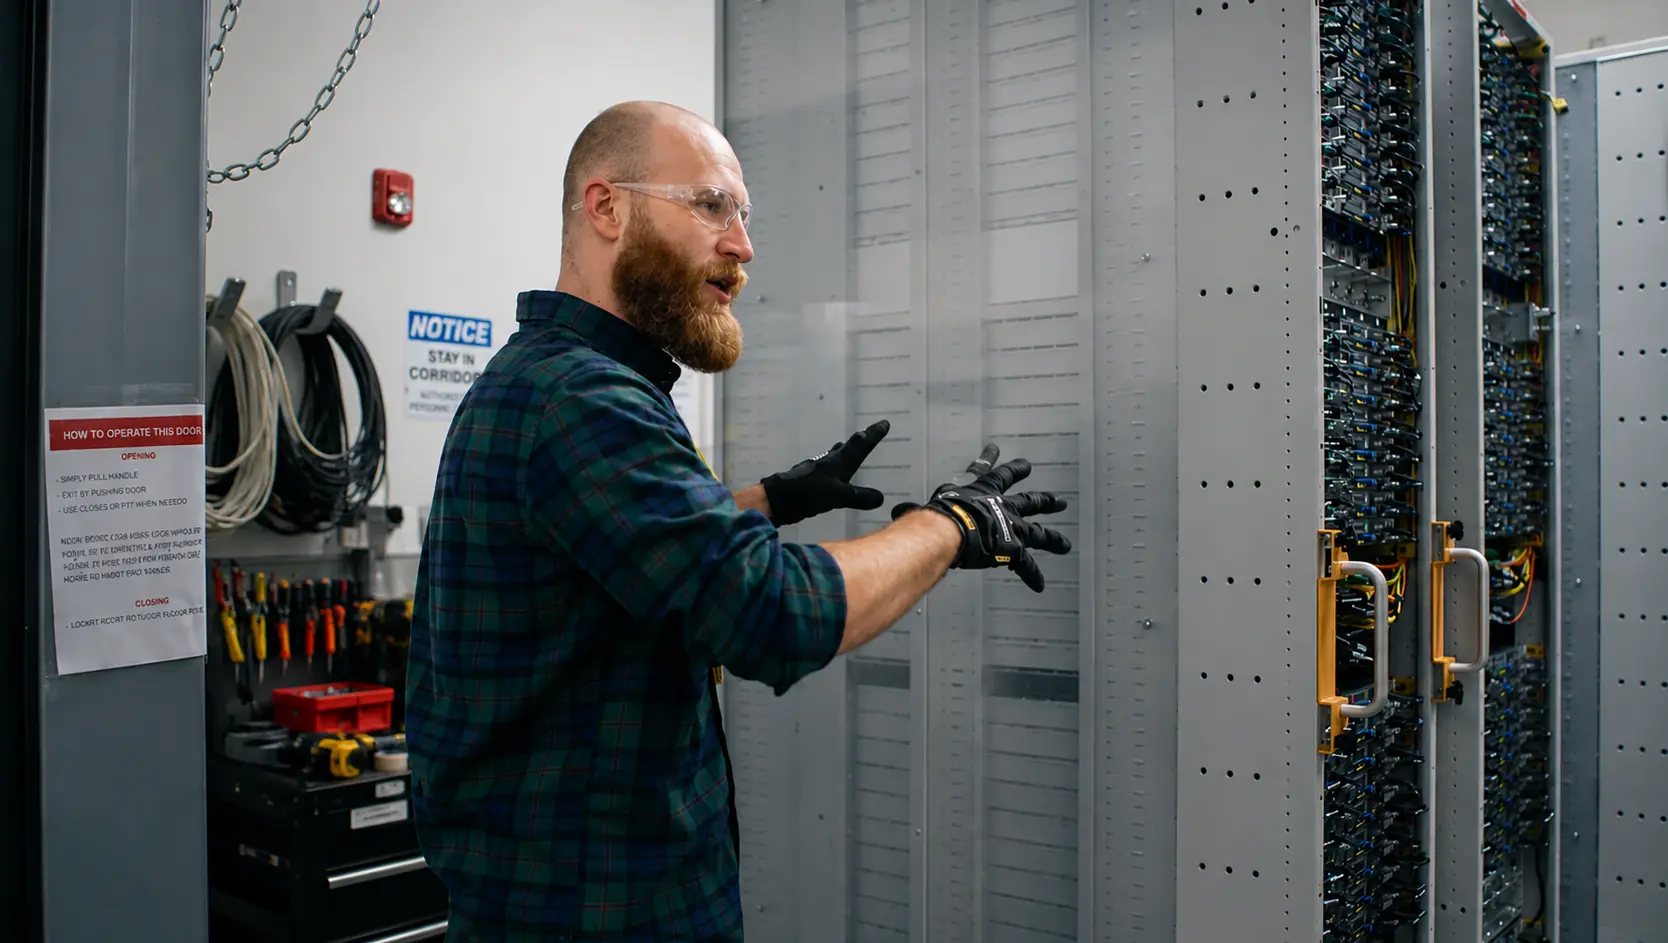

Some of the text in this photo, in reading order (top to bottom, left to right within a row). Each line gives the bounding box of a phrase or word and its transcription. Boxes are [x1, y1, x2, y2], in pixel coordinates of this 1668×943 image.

[410, 314, 489, 345] NOTICE
[428, 349, 475, 366] STAY IN
[63, 426, 202, 440] HOW TO OPERATE THIS DOOR
[121, 452, 156, 461] OPENING
[60, 471, 139, 484] SIMPLY PULL HANDLE
[62, 490, 79, 499] EXIT
[125, 486, 147, 494] DOOR
[62, 505, 78, 514] USE
[79, 502, 108, 513] CLOSES
[109, 501, 120, 510] OR
[135, 499, 158, 508] WHEN
[135, 597, 170, 608] CLOSING
